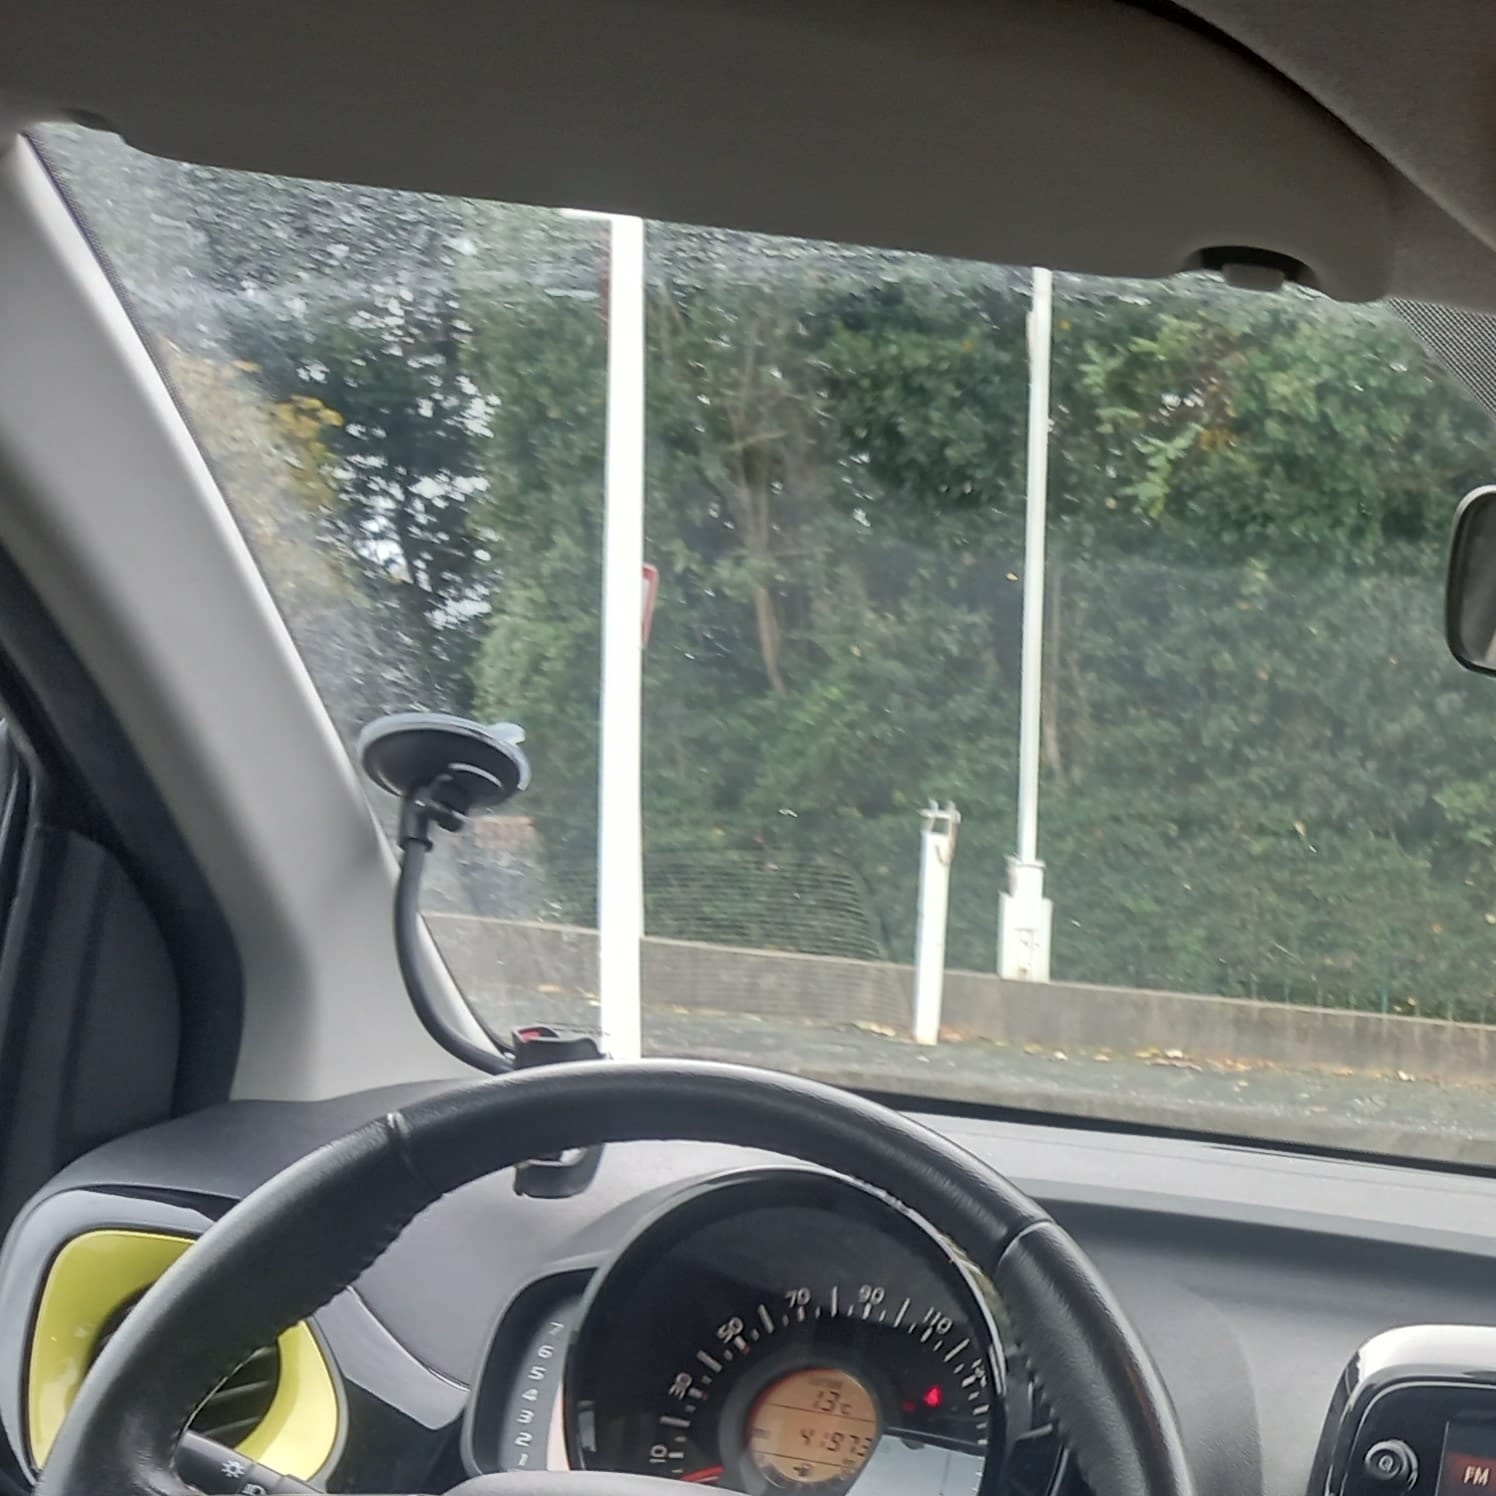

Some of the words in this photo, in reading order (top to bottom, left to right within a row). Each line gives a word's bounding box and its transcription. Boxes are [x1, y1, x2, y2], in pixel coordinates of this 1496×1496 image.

[786, 1288, 811, 1309] 70
[859, 1285, 885, 1305] 90
[922, 1306, 953, 1334] 110
[716, 1317, 744, 1344] 50
[538, 1345, 554, 1358] 6
[528, 1366, 547, 1380] 5
[522, 1389, 538, 1400] 4
[668, 1372, 692, 1399] 30
[516, 1410, 535, 1424] 3
[515, 1432, 533, 1446] 2
[518, 1454, 528, 1466] 1
[649, 1444, 668, 1463] 10
[1464, 1465, 1490, 1487] FM
